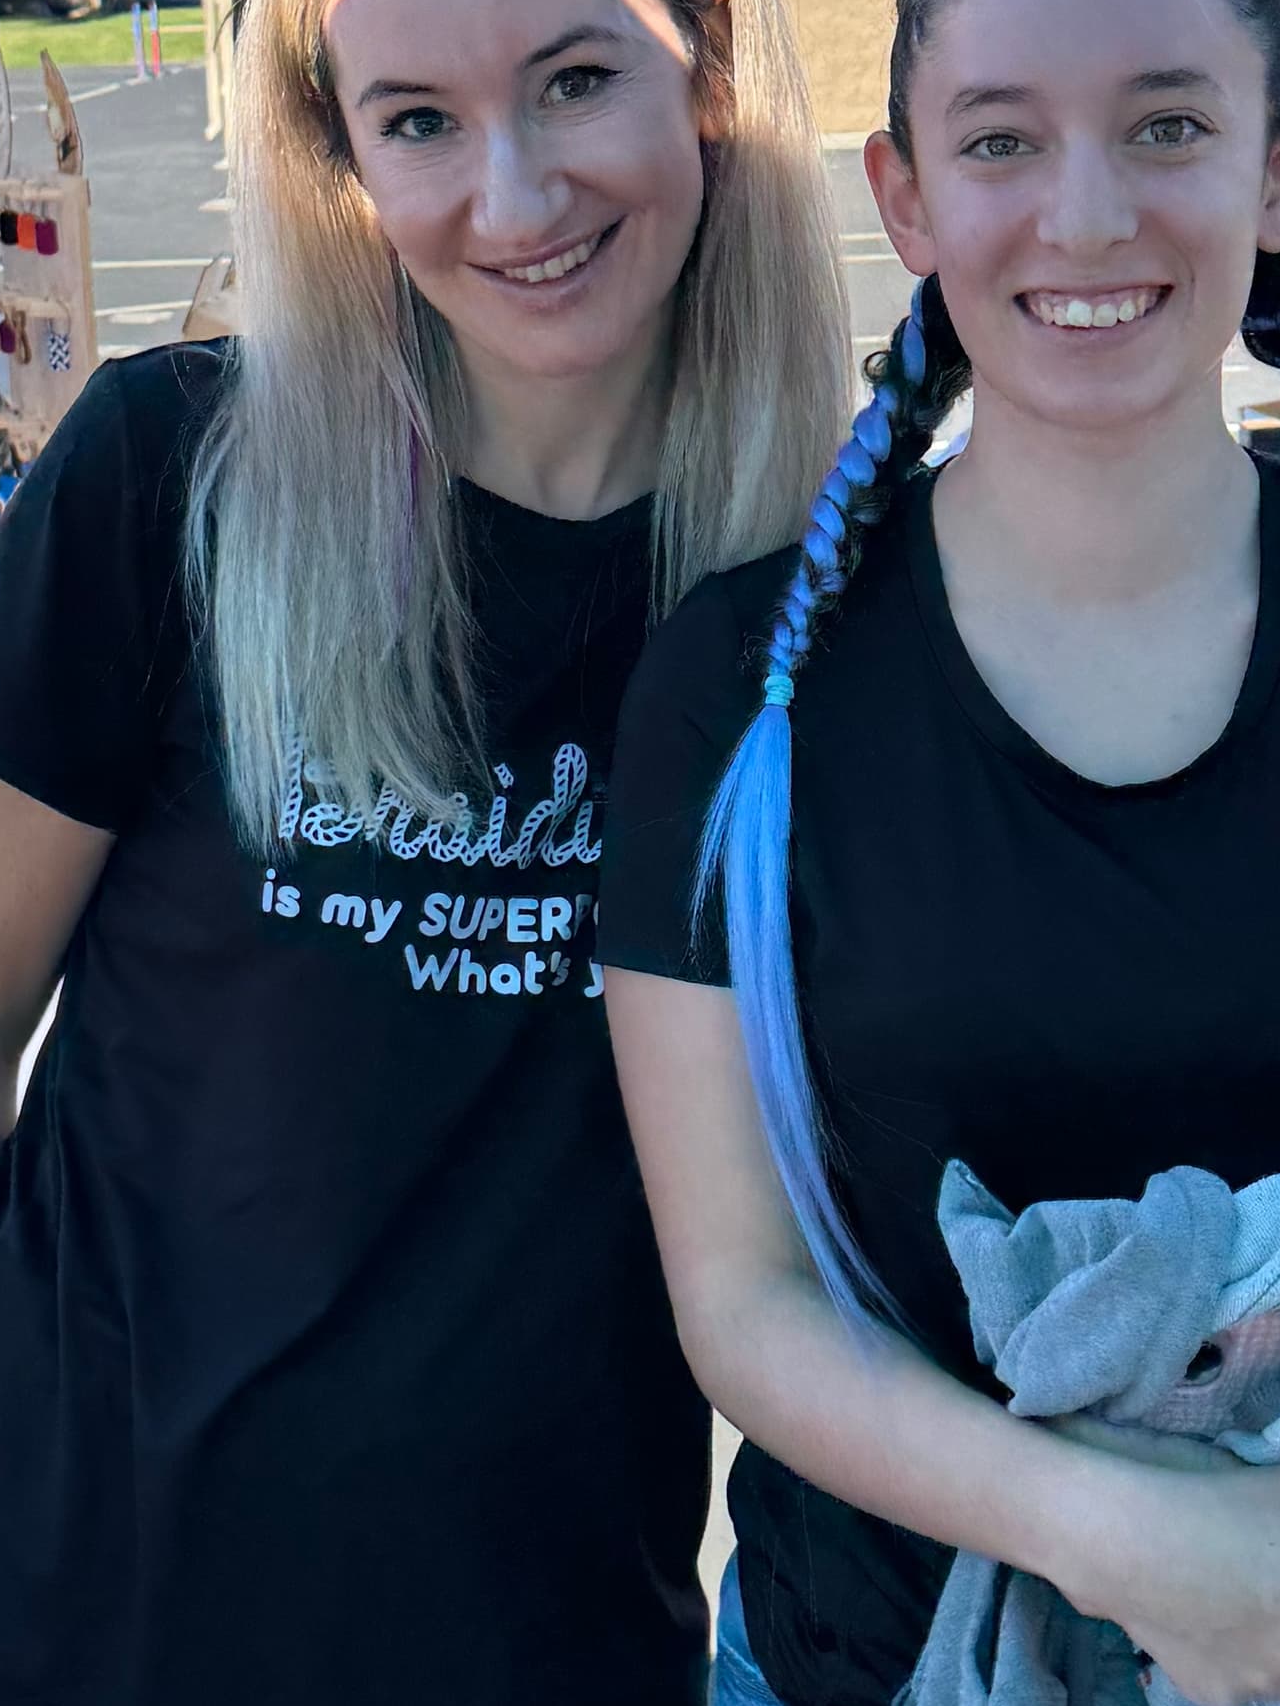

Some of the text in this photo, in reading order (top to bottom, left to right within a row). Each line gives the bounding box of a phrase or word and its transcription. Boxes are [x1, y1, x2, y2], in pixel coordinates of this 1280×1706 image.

[261, 867, 600, 944] is my SUPERP
[403, 943, 571, 995] What's
